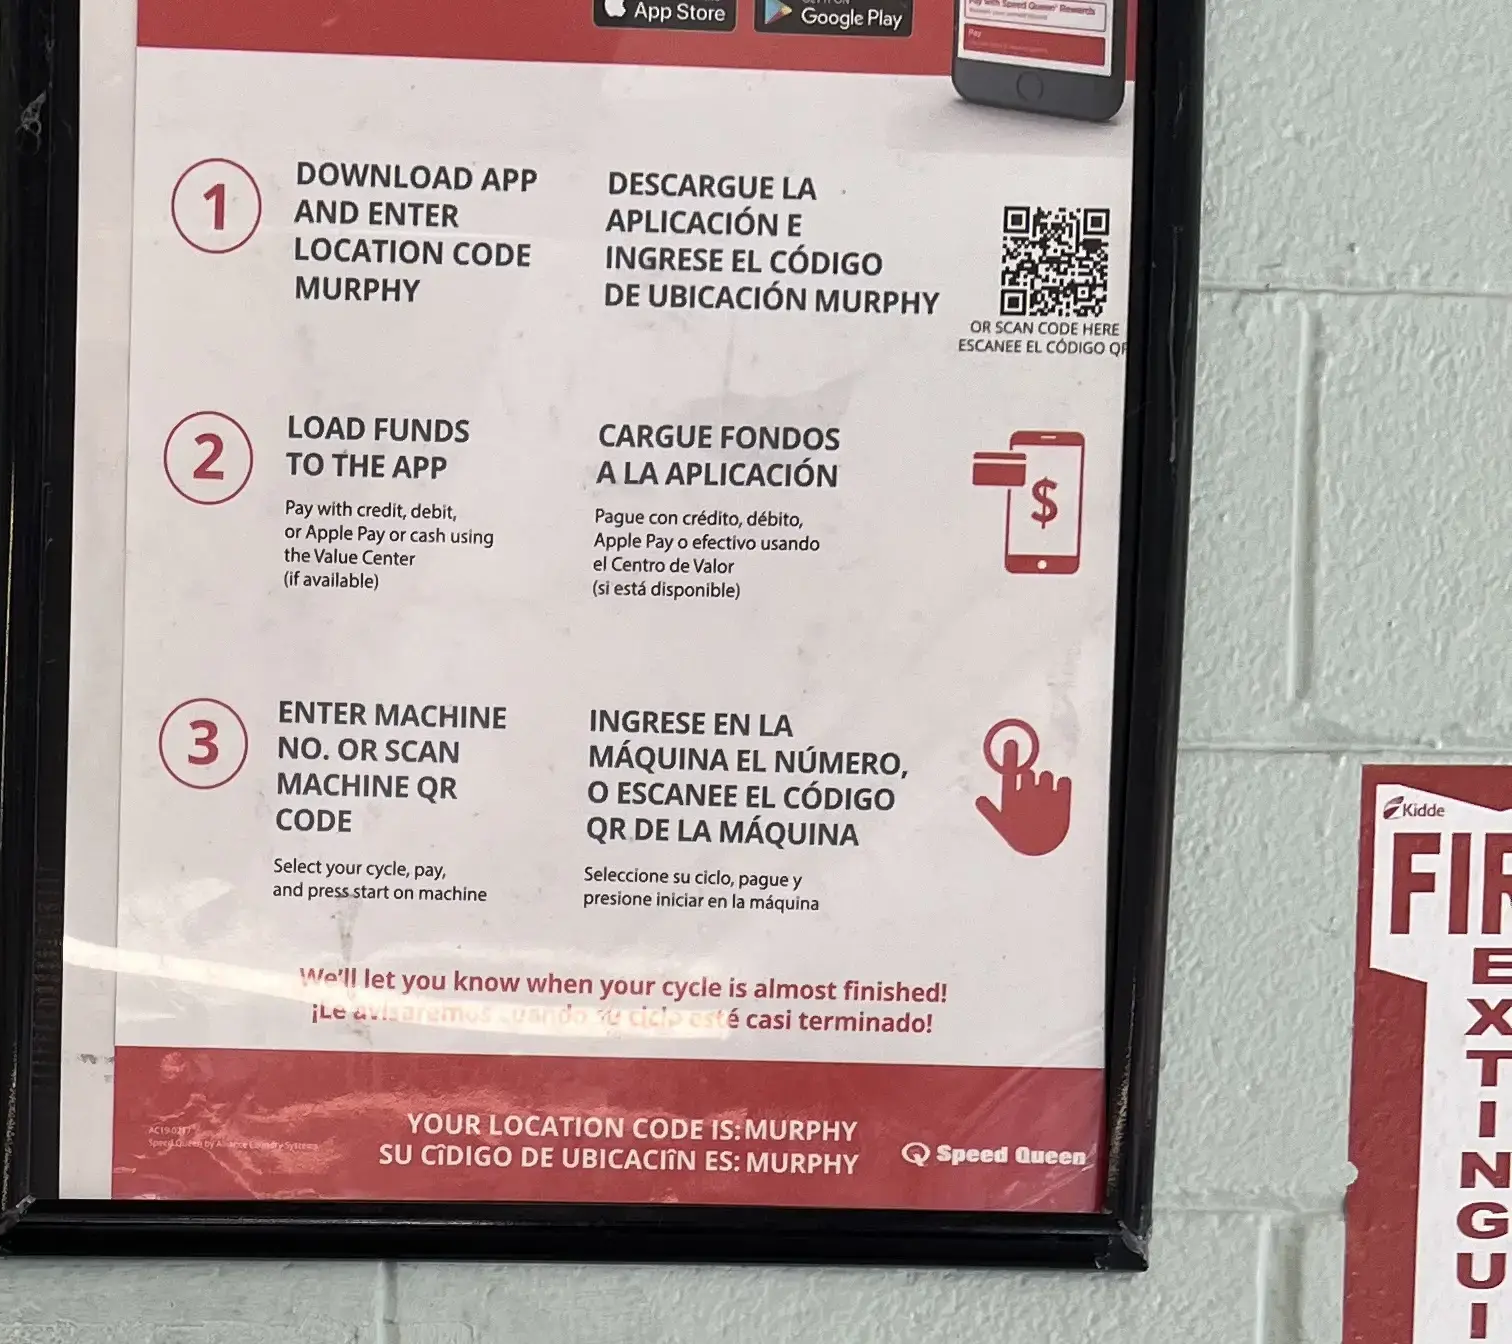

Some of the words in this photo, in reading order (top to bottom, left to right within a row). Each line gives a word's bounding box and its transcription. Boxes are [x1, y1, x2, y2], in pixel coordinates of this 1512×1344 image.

[634, 2, 672, 22] App
[677, 3, 725, 21] Store
[802, 7, 863, 29] Google
[868, 9, 902, 30] Play
[297, 162, 472, 190] DOWNLOAD
[481, 168, 537, 192] APP
[609, 172, 774, 199] DESCARGUE
[783, 176, 817, 200] LA
[204, 184, 225, 230] 1
[294, 199, 358, 224] AND
[369, 202, 459, 228] ENTER
[606, 206, 778, 236] APLICACIÓN
[788, 214, 802, 237] E
[295, 237, 443, 264] LOCATION
[453, 242, 531, 267] CODE
[607, 246, 723, 272] INGRESE
[732, 249, 762, 273] EL
[770, 244, 882, 276] CÓDIGO
[296, 276, 420, 302] MURPHY
[605, 283, 640, 306] DE
[649, 281, 806, 310] UBICACIÓN
[816, 289, 940, 314] MURPHY
[971, 320, 991, 333] OR
[996, 321, 1033, 334] SCAN
[1038, 322, 1078, 335] CODE
[1083, 323, 1119, 336] HERE
[959, 339, 1022, 353] ESCANEE
[1027, 340, 1042, 353] EL
[1046, 338, 1105, 355] CÓDIGO
[289, 415, 365, 440] LOAD
[375, 418, 469, 443] FUNDS
[193, 433, 224, 480] 2
[286, 452, 324, 476] TO
[332, 454, 385, 477] THE
[392, 456, 447, 479] APP
[286, 500, 313, 519] Pay
[317, 501, 352, 516] with
[357, 502, 406, 520] credit,
[411, 503, 456, 522] debit,
[285, 525, 301, 544] or
[306, 525, 353, 543] Apple
[358, 526, 385, 545] Pay
[390, 526, 406, 546] or
[410, 526, 445, 546] cash
[451, 529, 493, 548] using
[284, 547, 310, 563] the
[314, 548, 358, 564] Value
[363, 550, 415, 566] Center
[284, 571, 300, 588] (if
[303, 572, 378, 591] available)
[279, 701, 367, 725] ENTER
[375, 704, 506, 729] MACHINE
[188, 720, 218, 765] 3
[279, 736, 329, 760] NO.
[338, 738, 378, 761] OR
[385, 740, 459, 763] SCAN
[278, 772, 409, 798] MACHINE
[417, 776, 457, 804] QR
[276, 808, 351, 832] CODE
[1403, 803, 1445, 817] Kidde
[365, 968, 395, 989] let
[402, 975, 445, 995] you
[454, 970, 520, 992] know
[527, 973, 592, 993] when
[600, 980, 656, 1000] your
[662, 977, 722, 1002] cycle
[729, 977, 747, 997] is
[754, 978, 837, 1000] almost
[843, 980, 946, 1003] finished!
[407, 1113, 481, 1135] YOUR
[490, 1115, 624, 1137] LOCATION
[633, 1118, 703, 1139] CODE
[712, 1120, 741, 1140] IS:
[745, 1119, 857, 1141] MURPHY
[380, 1144, 412, 1164] SU
[522, 1147, 553, 1167] DE
[706, 1151, 739, 1171] ES:
[747, 1152, 859, 1174] MURPHY
[937, 1145, 1008, 1165] Speed
[1016, 1147, 1087, 1165] Queen
